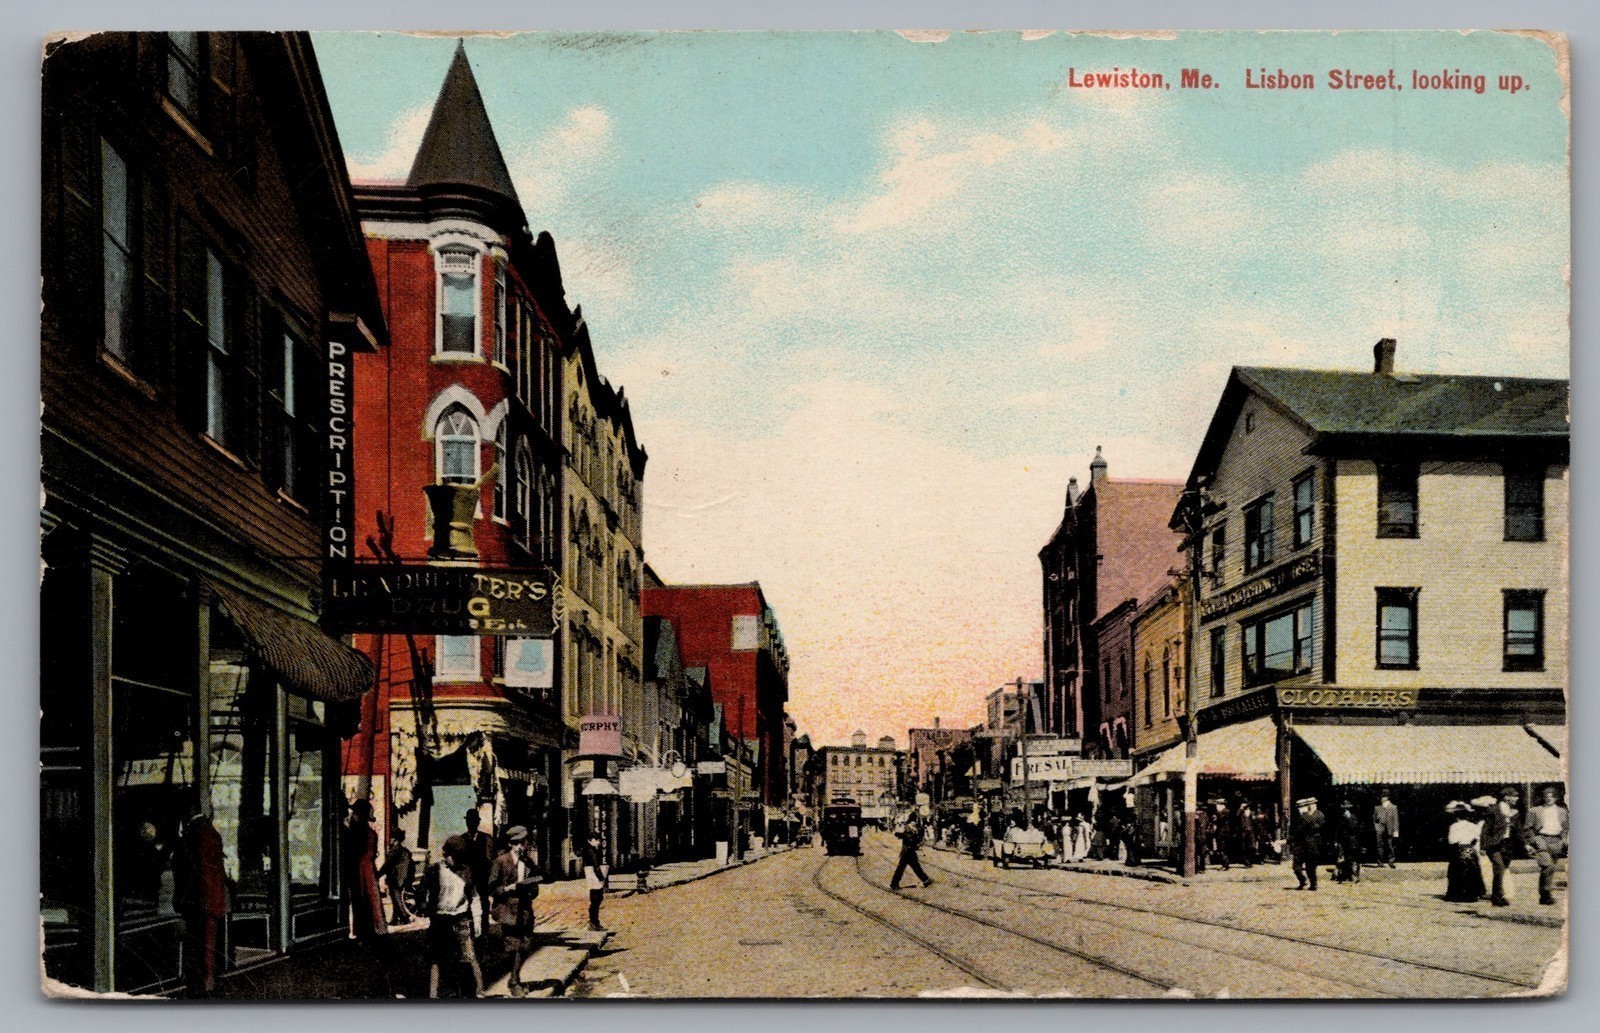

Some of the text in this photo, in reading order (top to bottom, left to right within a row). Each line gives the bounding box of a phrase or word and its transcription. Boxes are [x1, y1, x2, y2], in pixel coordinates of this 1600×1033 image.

[328, 341, 348, 558] PRESCRIPTION
[1279, 689, 1413, 708] CLOTHIERS
[581, 721, 619, 732] URPHY
